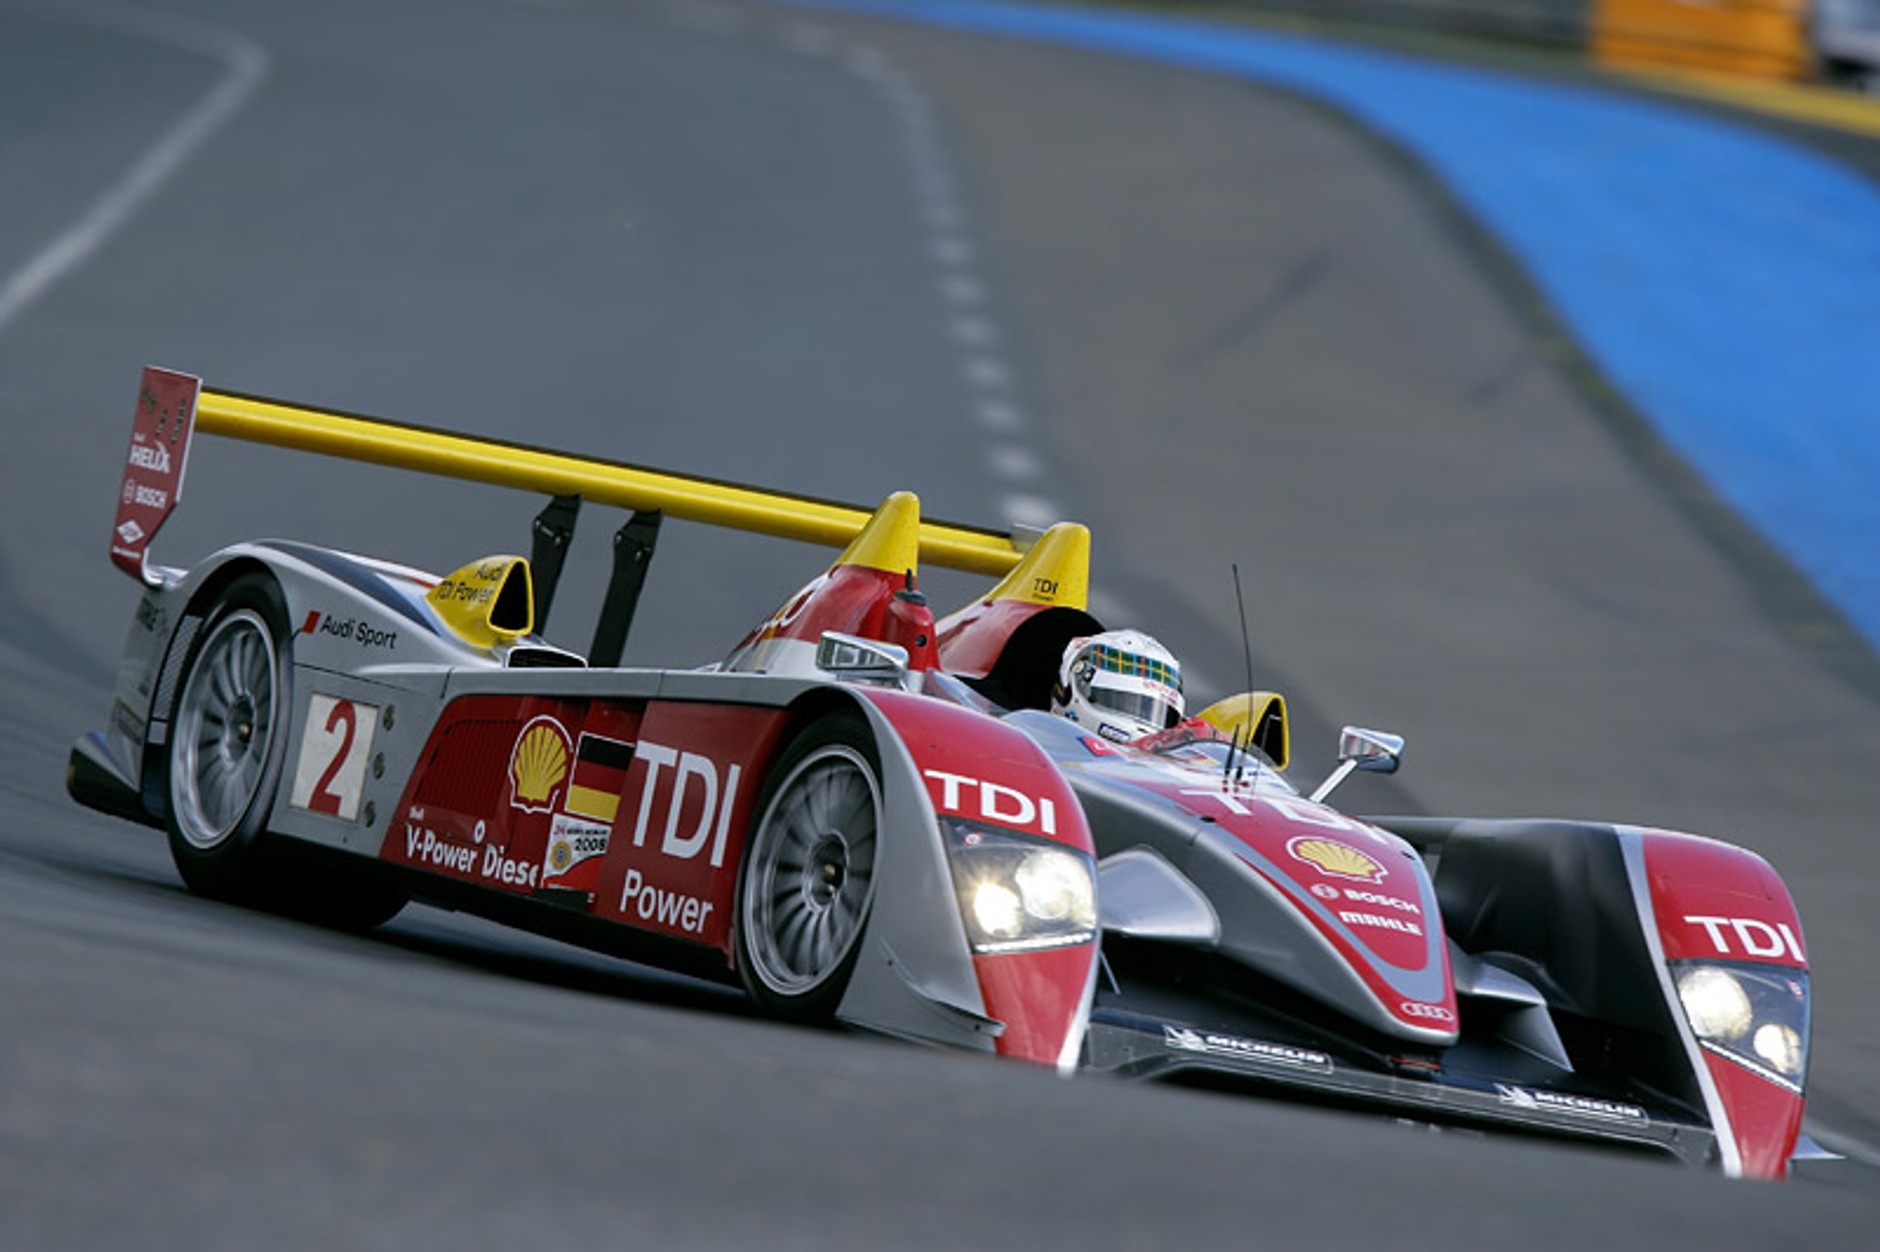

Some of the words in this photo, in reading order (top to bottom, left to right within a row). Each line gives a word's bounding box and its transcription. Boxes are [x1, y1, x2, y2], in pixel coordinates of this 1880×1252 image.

[129, 440, 170, 473] HELIX
[1034, 578, 1058, 595] TDI
[320, 615, 356, 638] Audi
[356, 622, 396, 649] Sport
[308, 699, 356, 816] 2
[633, 740, 741, 867] TDI
[924, 769, 1056, 835] TDI
[405, 822, 477, 872] V-Power
[620, 869, 713, 933] Power
[1343, 888, 1420, 914] BOSCH
[1683, 915, 1806, 962] TDI
[1206, 1036, 1324, 1063] MICHELIN
[1535, 1092, 1640, 1117] MICHELIN
